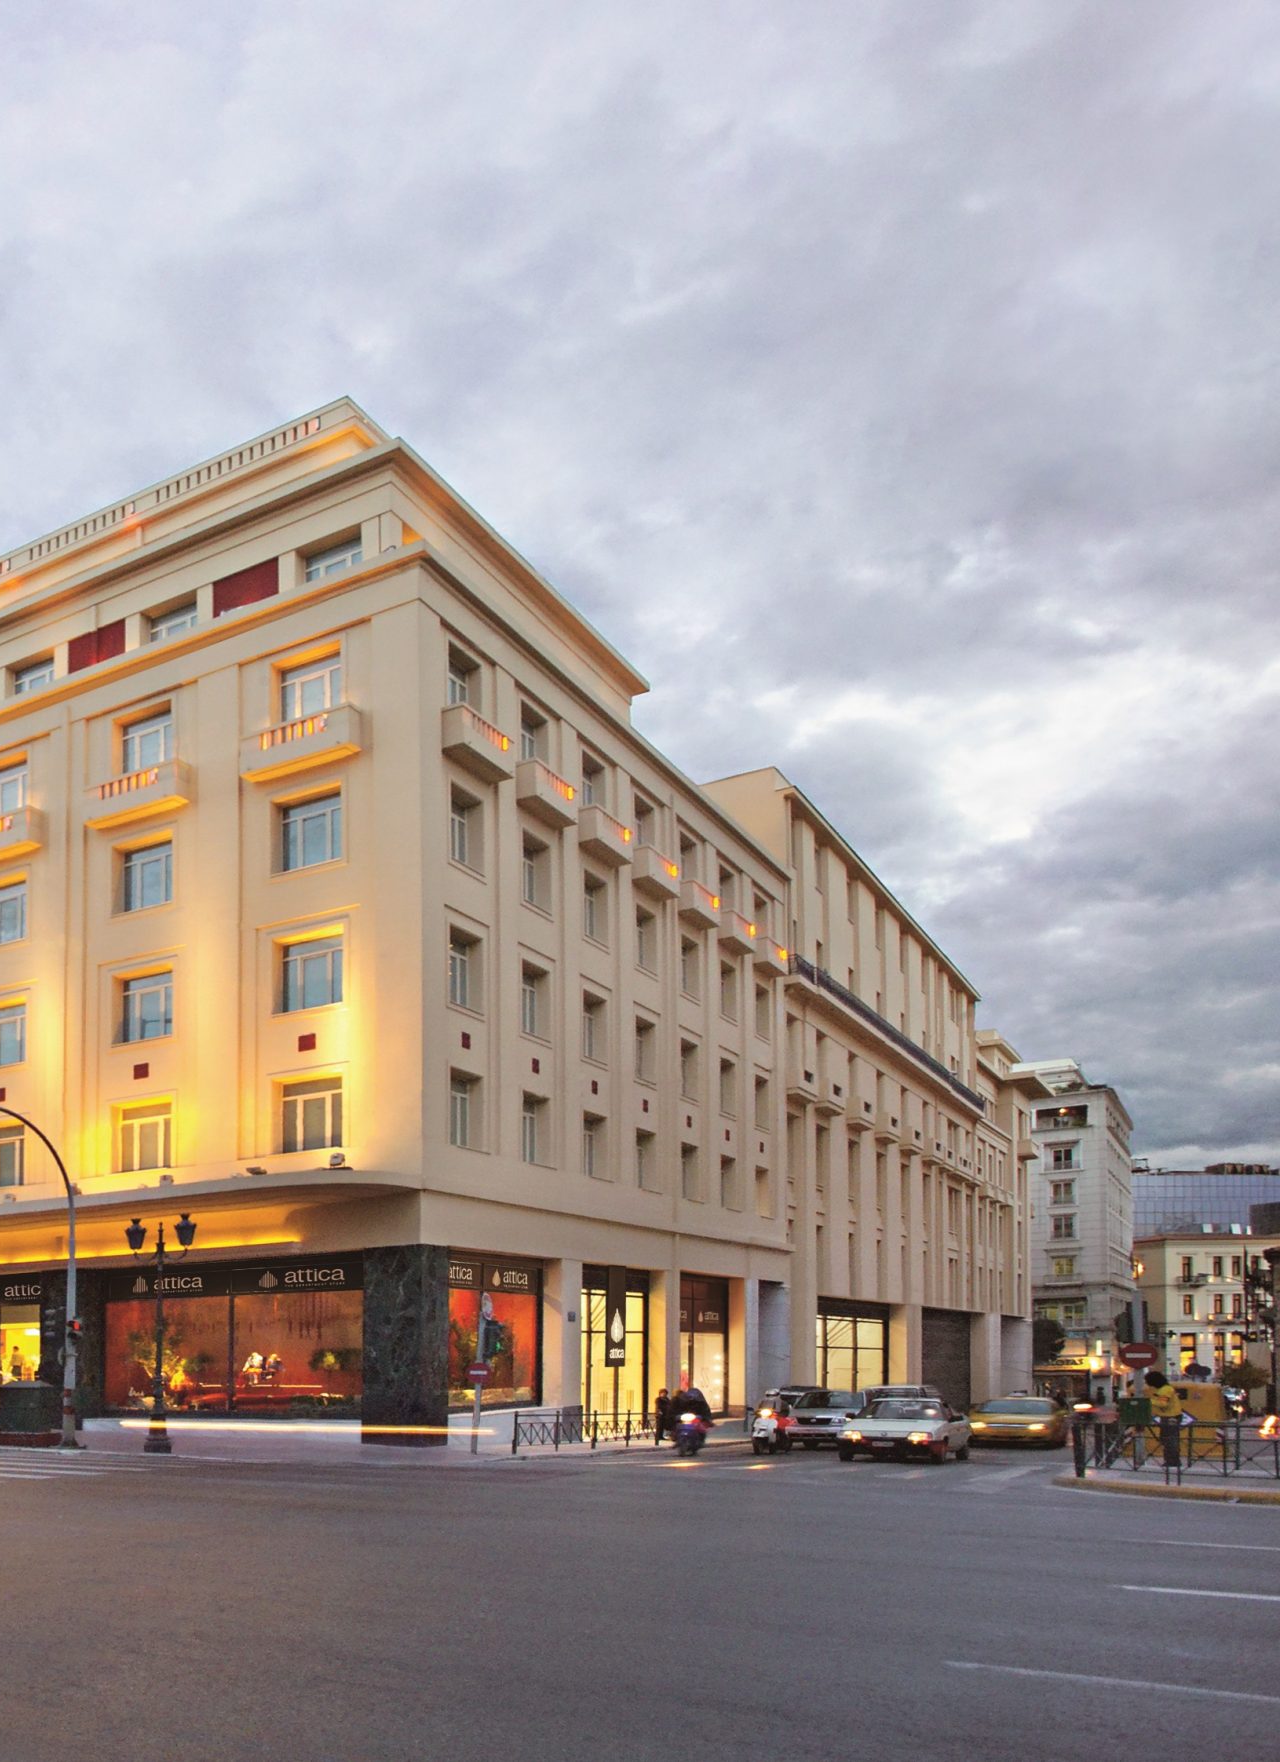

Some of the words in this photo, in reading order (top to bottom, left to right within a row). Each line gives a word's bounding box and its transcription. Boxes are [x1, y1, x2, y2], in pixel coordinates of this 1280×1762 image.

[153, 1276, 203, 1290] attica
[284, 1268, 345, 1284] attica
[503, 1270, 528, 1285] attica
[4, 1284, 41, 1297] attic
[609, 1348, 624, 1359] attica
